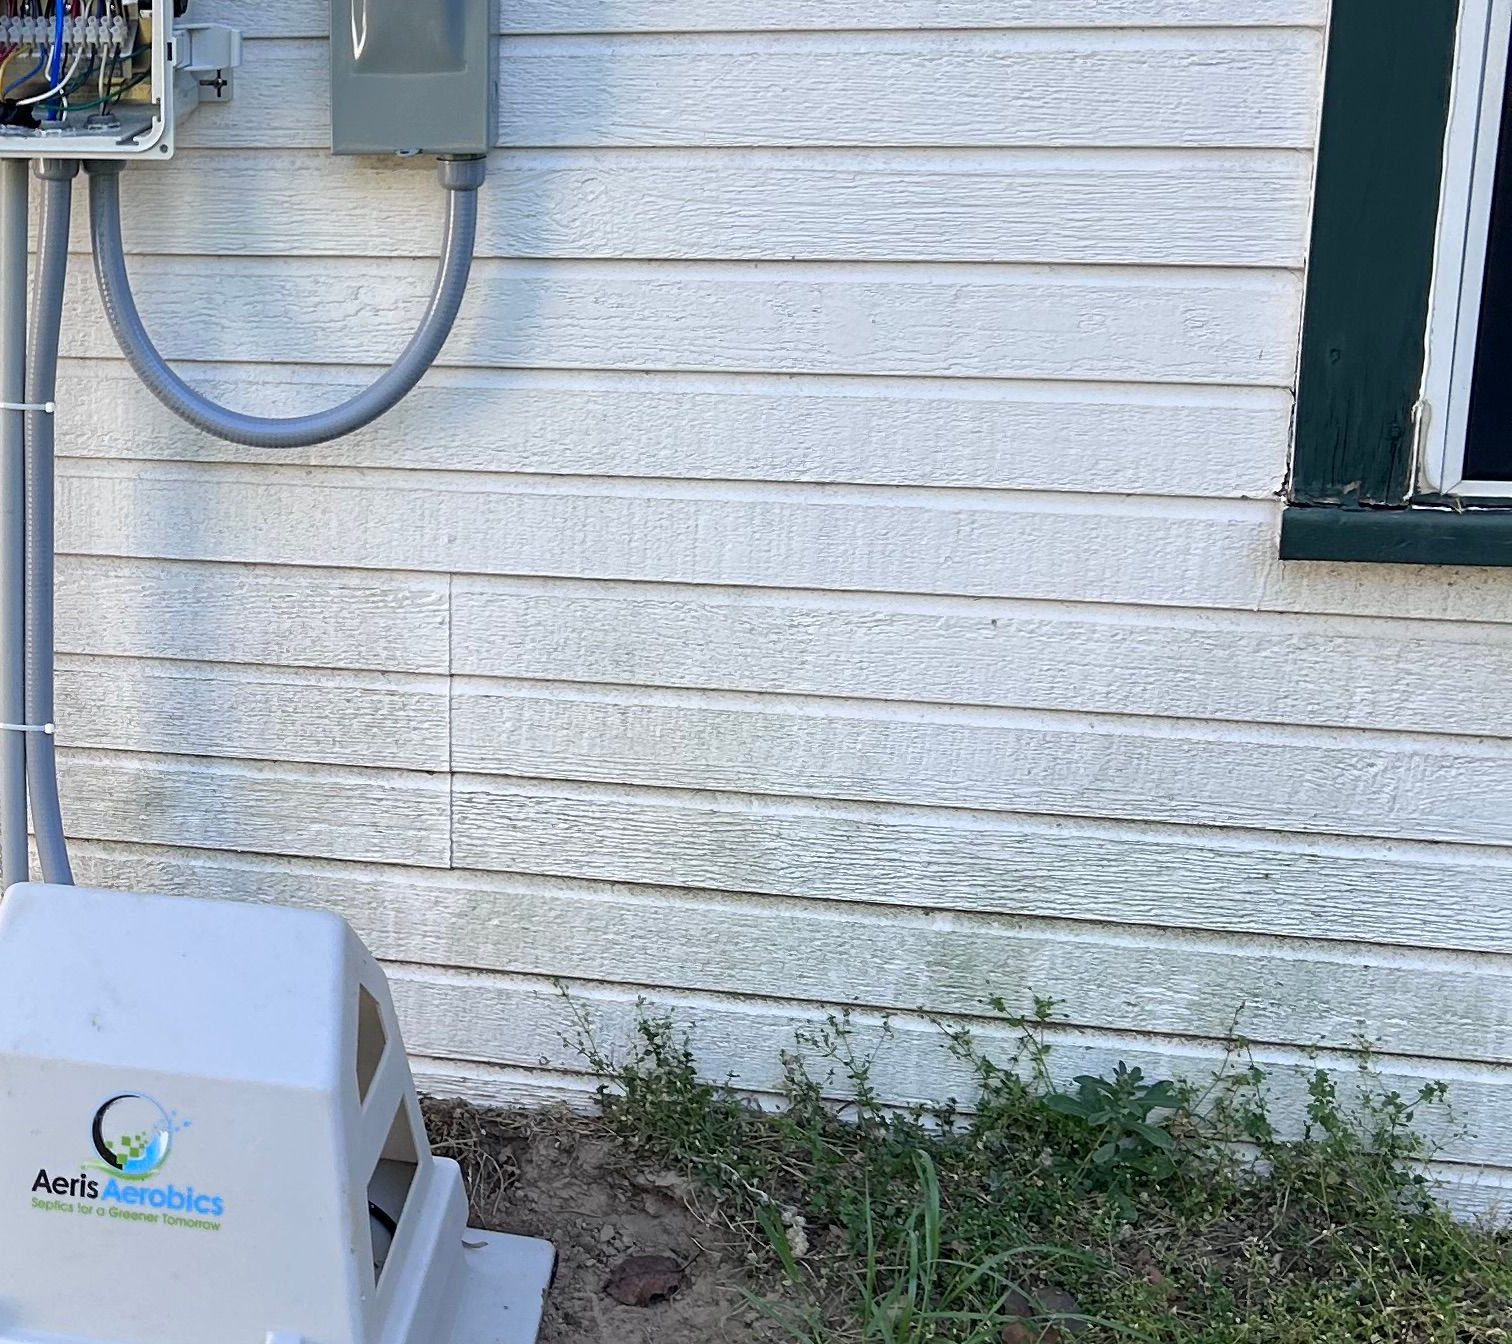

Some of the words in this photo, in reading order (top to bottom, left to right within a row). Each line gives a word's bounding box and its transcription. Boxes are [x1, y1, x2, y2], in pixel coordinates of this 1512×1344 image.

[31, 1168, 99, 1199] Aeris
[100, 1177, 224, 1217] Aerobics
[31, 1197, 73, 1213] Septics
[77, 1203, 92, 1214] for
[96, 1208, 105, 1217] a
[108, 1207, 158, 1224] Greener
[161, 1213, 221, 1232] Tomorrow
